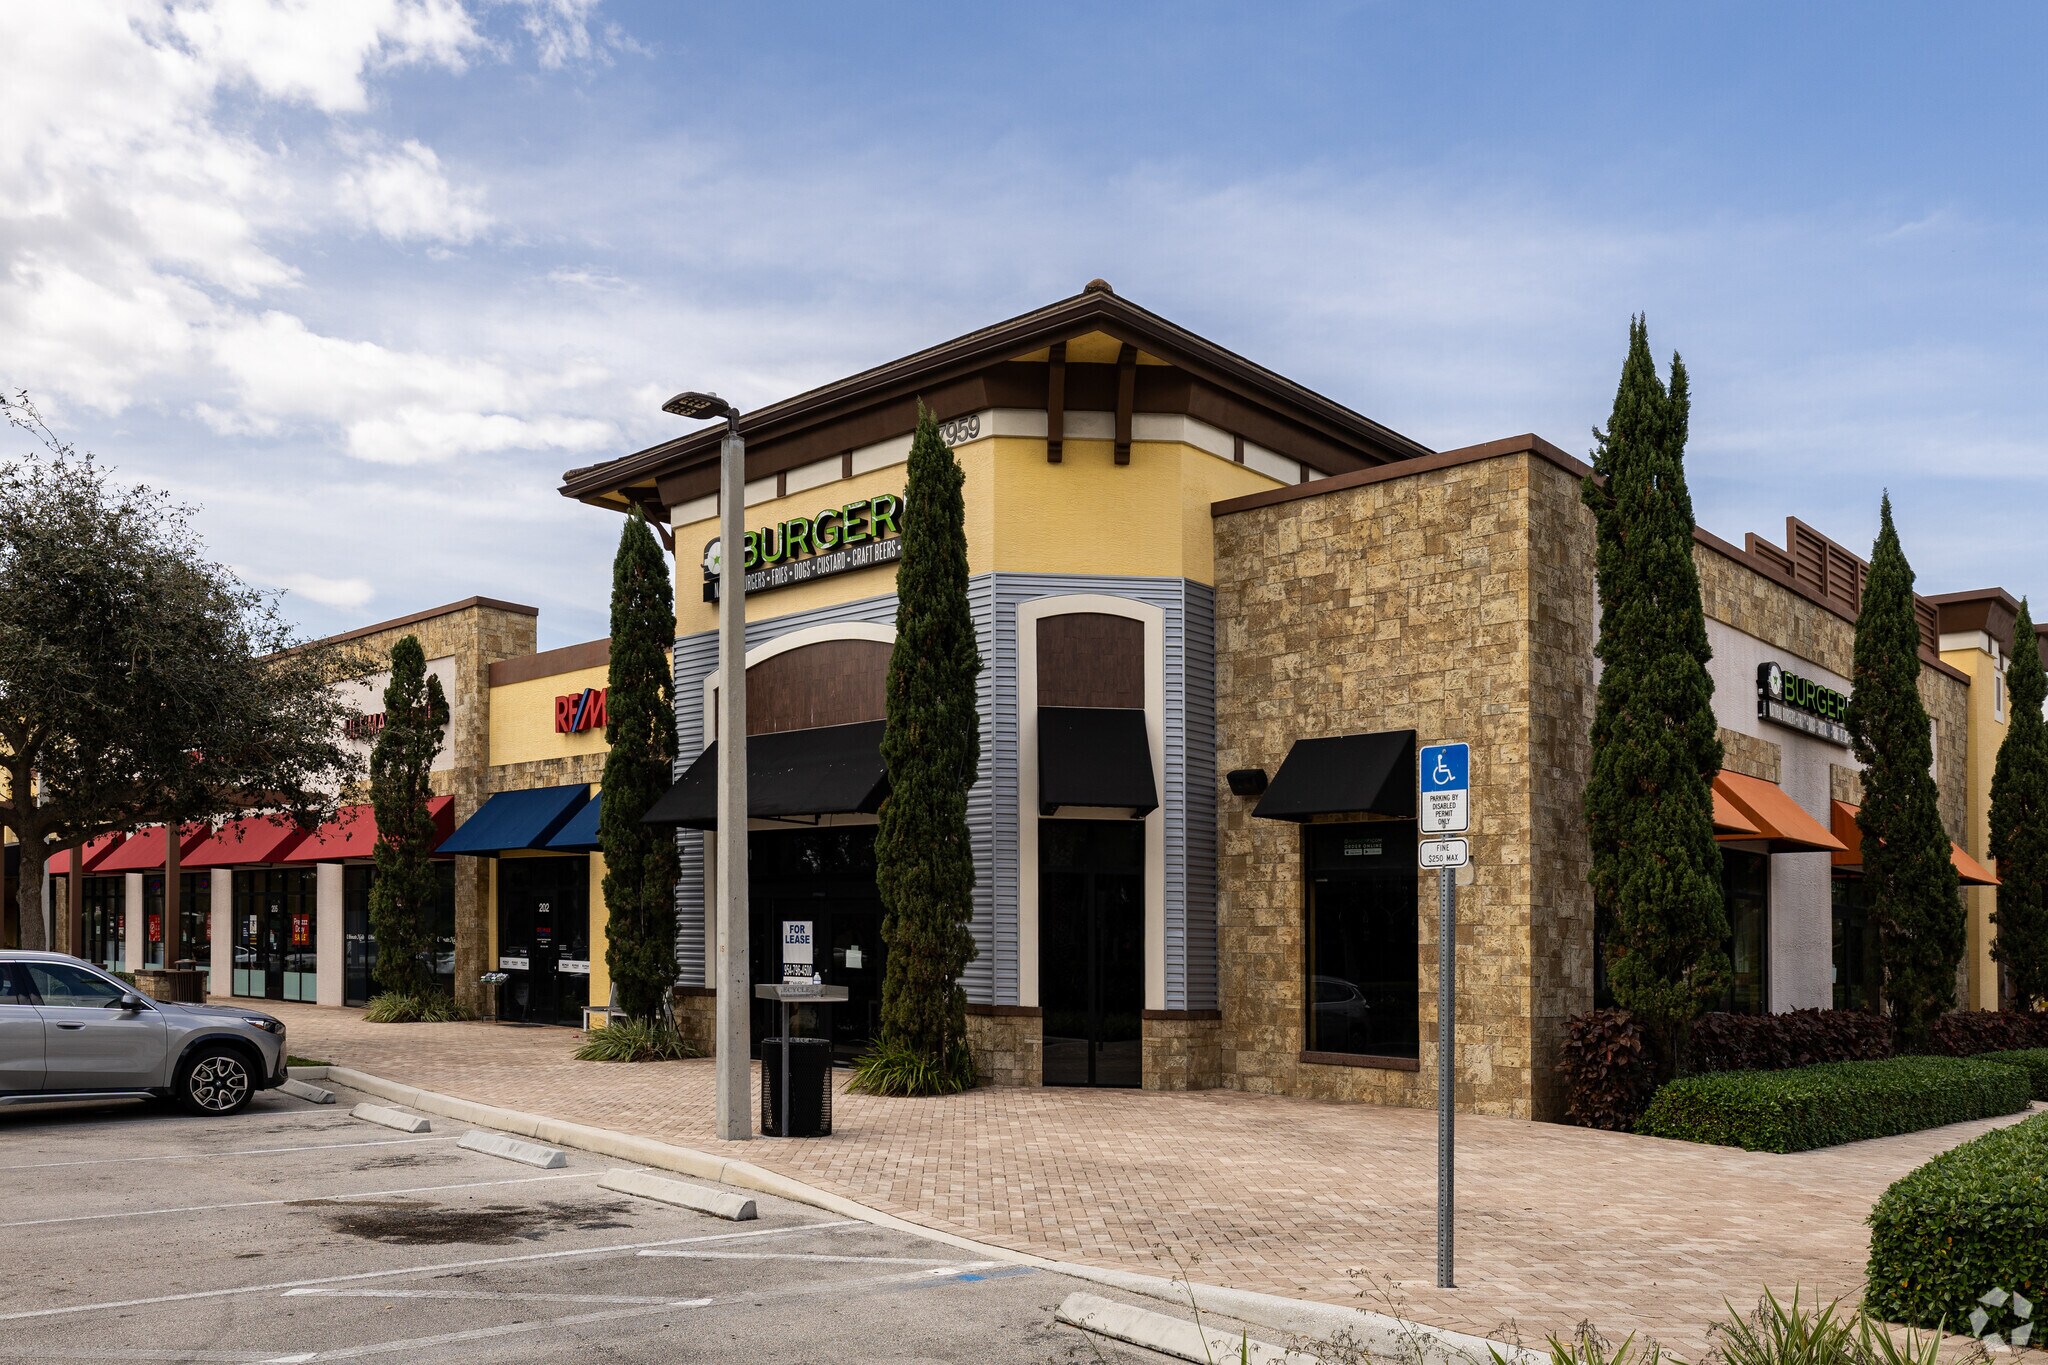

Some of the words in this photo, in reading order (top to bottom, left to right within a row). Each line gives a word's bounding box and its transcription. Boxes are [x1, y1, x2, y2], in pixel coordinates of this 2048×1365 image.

[938, 414, 981, 445] 7959
[743, 490, 906, 568] BURGER
[771, 566, 788, 586] FRIES
[794, 560, 811, 580] DOGS
[816, 551, 846, 574] CUSTARD
[852, 544, 874, 566] CRAFT
[874, 539, 896, 561] BEERS
[1429, 794, 1451, 802] PARKING
[1432, 802, 1457, 810] DISABLED
[1428, 854, 1443, 863] $250
[538, 903, 550, 913] 202
[789, 924, 806, 934] FOR
[785, 935, 811, 944] LEASE
